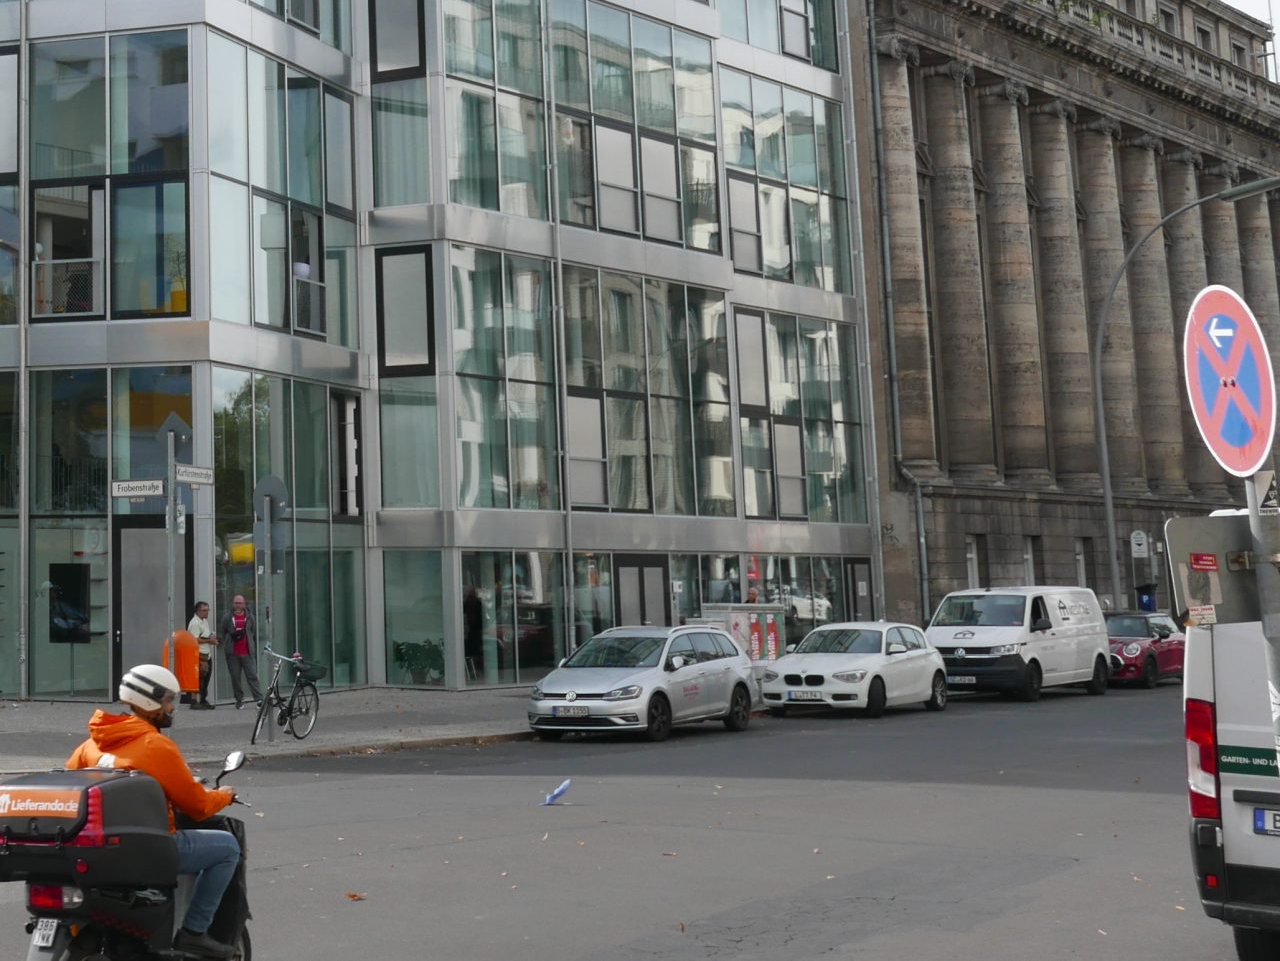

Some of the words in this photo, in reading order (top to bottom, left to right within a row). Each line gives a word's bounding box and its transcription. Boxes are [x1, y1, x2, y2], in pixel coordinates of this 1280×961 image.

[117, 483, 160, 493] Frobenstraße
[1221, 756, 1251, 764] GARTEN-
[1252, 758, 1268, 766] UND
[11, 799, 79, 812] Lieferando.de
